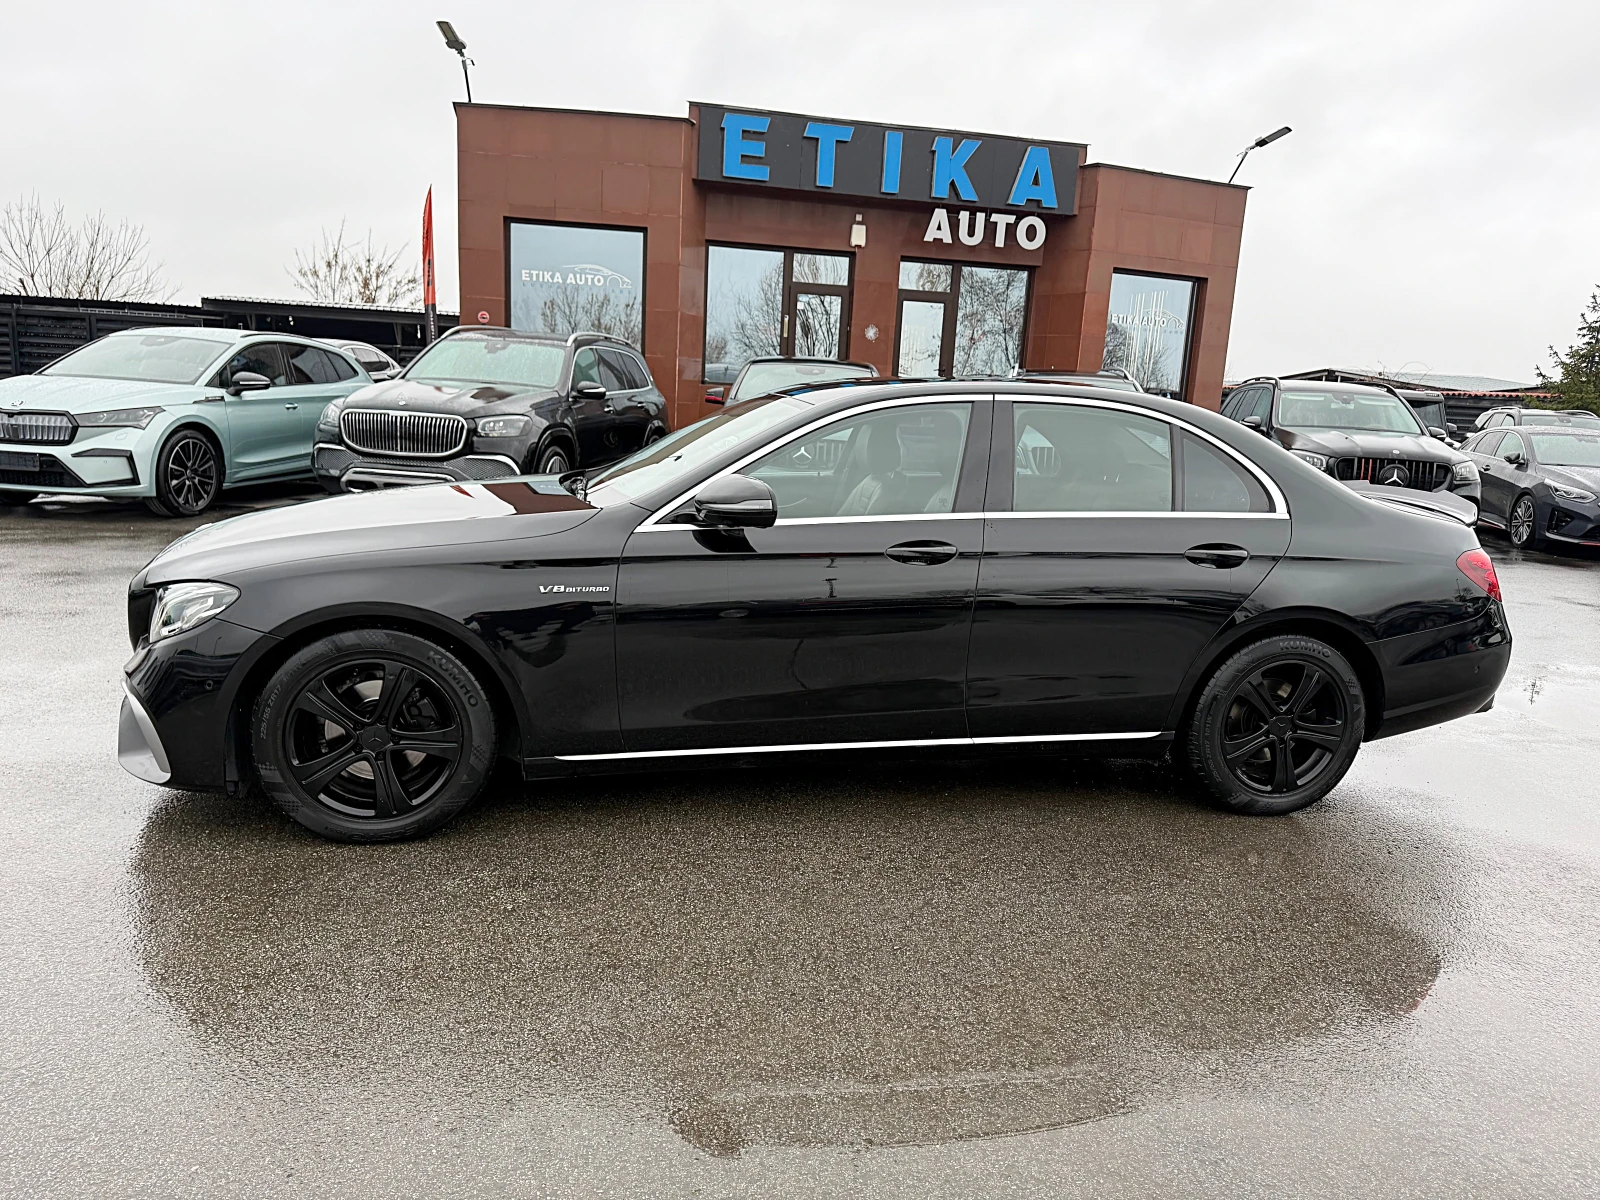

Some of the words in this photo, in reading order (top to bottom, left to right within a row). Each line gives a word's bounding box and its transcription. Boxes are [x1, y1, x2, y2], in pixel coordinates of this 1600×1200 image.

[721, 112, 1058, 209] ETIKA
[923, 208, 1046, 251] AUTO
[521, 269, 563, 284] ETIKA
[566, 273, 605, 286] AUTO
[1111, 313, 1139, 325] ETIKA
[1141, 315, 1167, 327] AUTO
[1279, 640, 1332, 659] KUMHO
[426, 650, 479, 709] KUMHO
